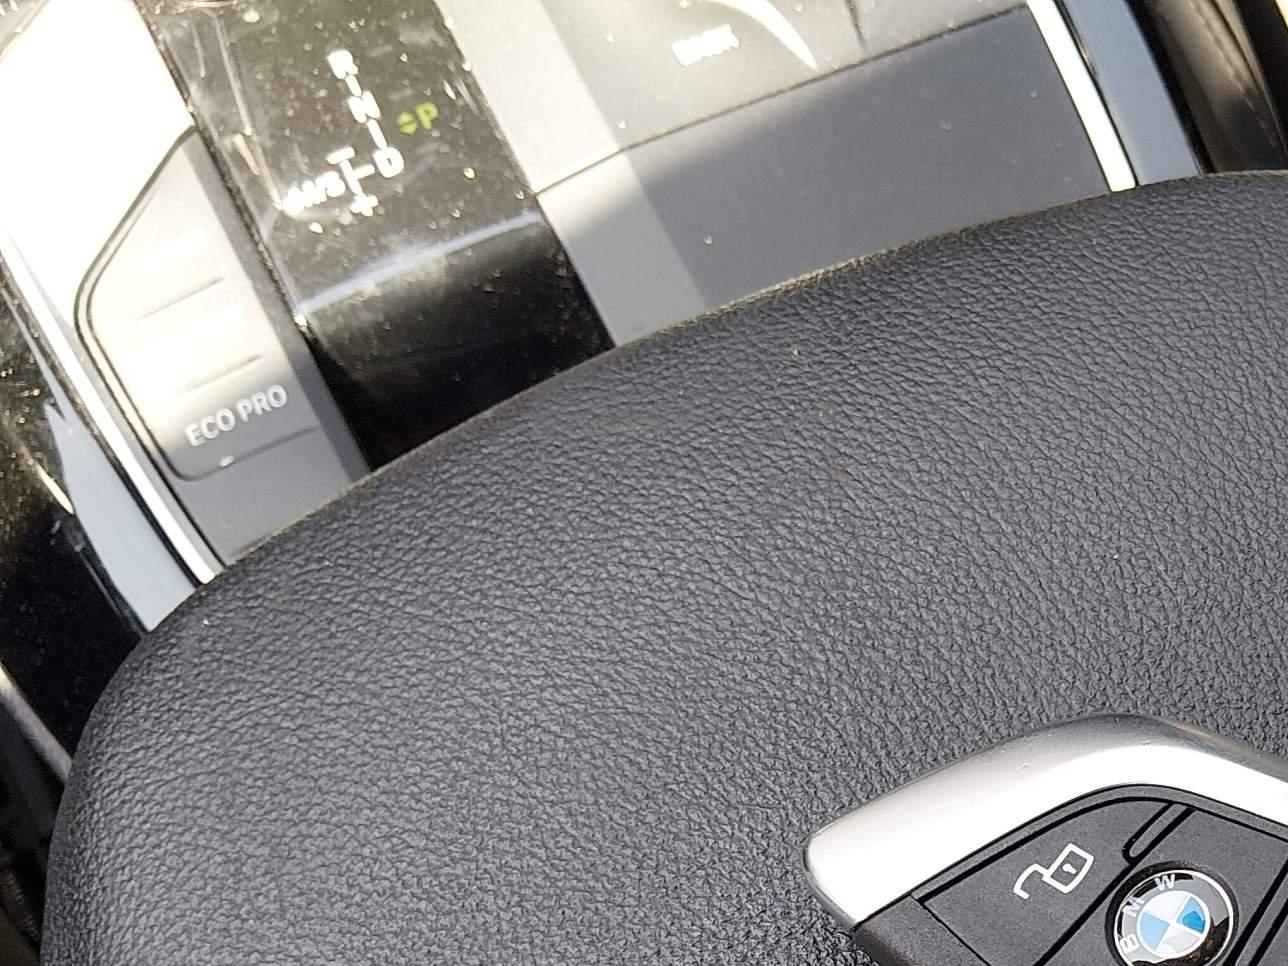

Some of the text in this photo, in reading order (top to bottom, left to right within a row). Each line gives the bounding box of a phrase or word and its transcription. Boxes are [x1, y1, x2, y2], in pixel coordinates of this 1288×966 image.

[327, 50, 359, 80] R
[416, 102, 438, 129] P
[373, 147, 405, 179] D
[185, 384, 288, 447] ECO PRO
[1119, 873, 1176, 955] BMW
